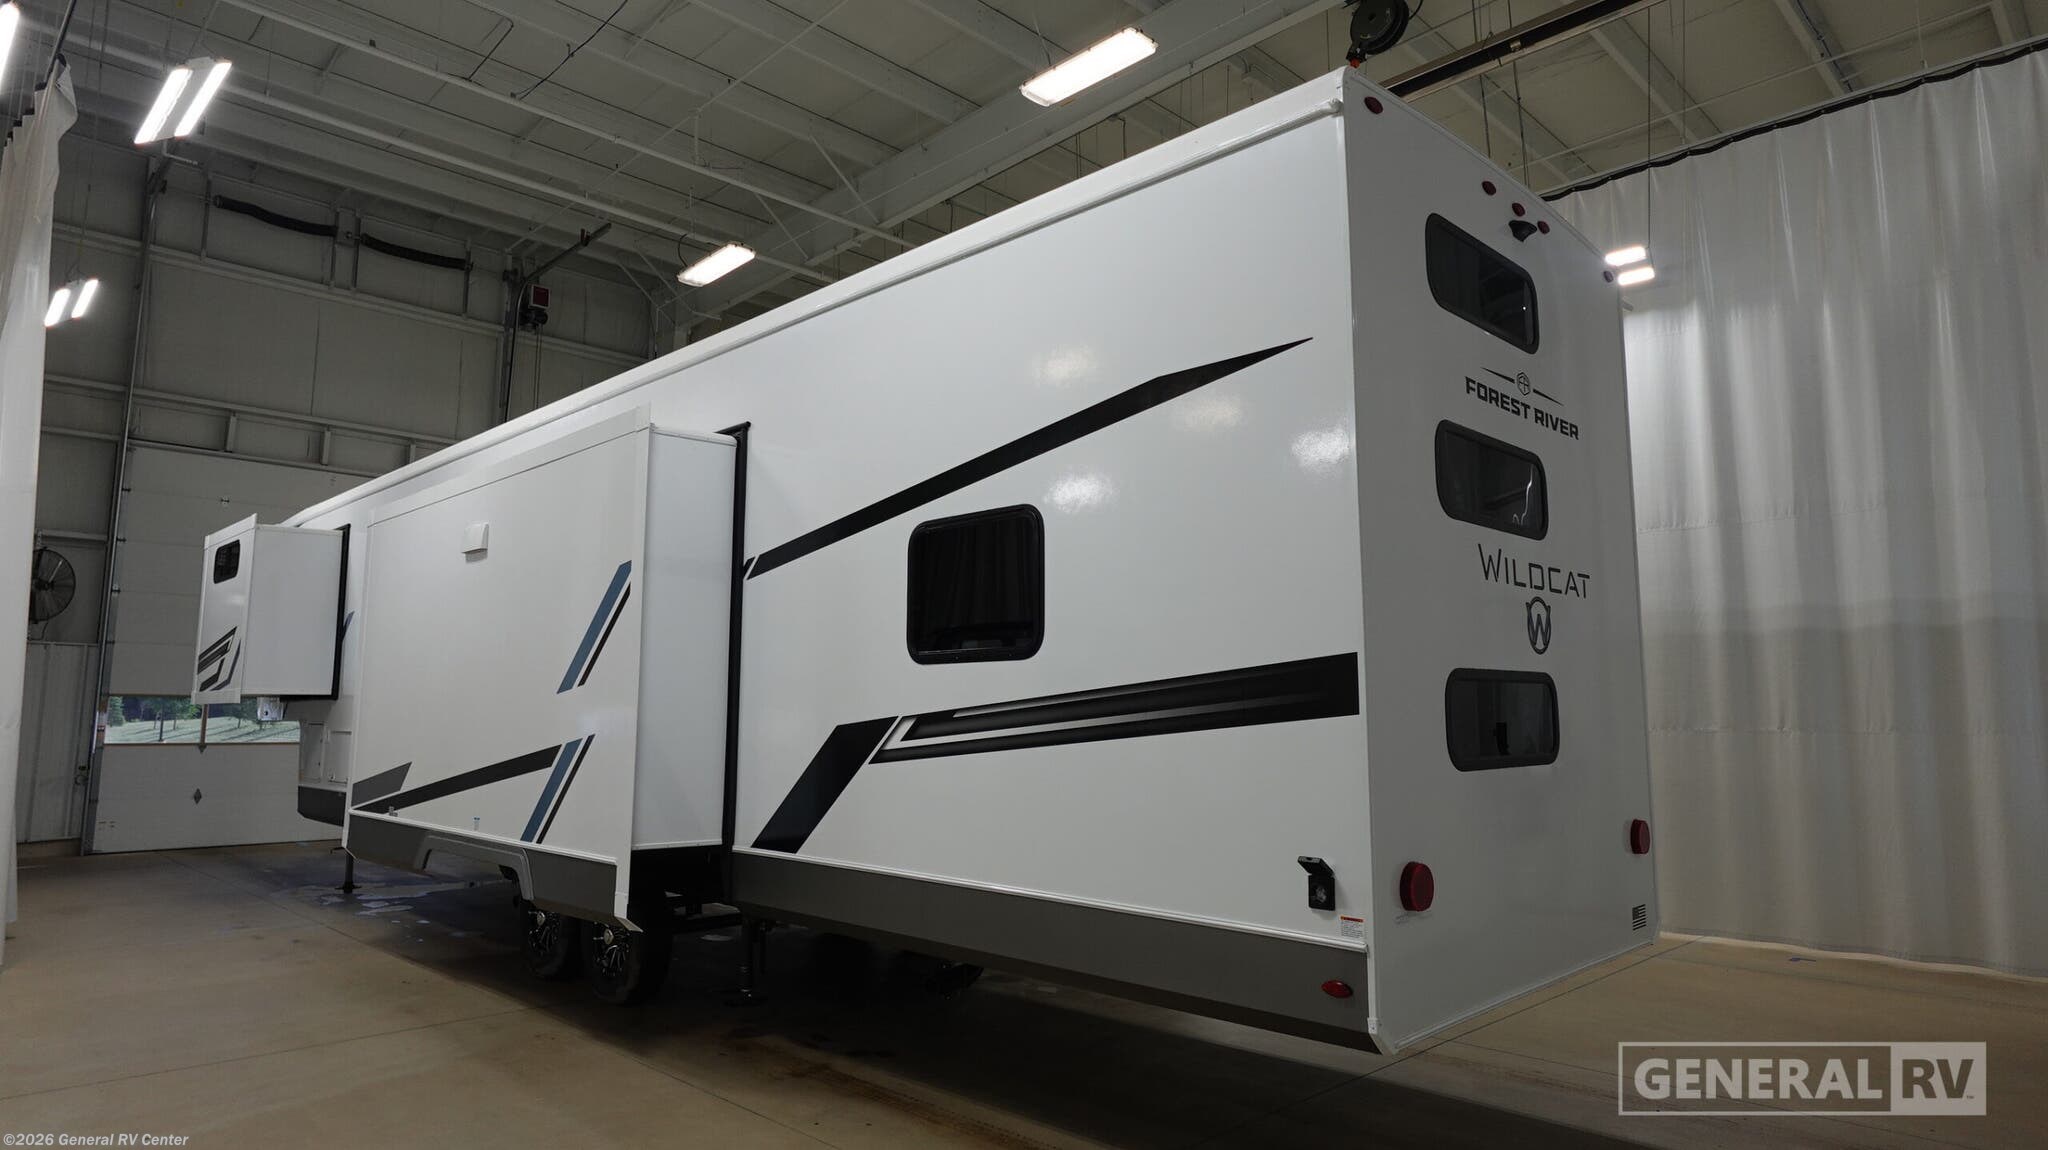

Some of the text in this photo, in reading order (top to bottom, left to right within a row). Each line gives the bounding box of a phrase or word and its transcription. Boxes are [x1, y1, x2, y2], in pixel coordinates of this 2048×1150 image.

[1465, 376, 1579, 440] FOREST RIVER
[1478, 543, 1590, 599] WILDCAT
